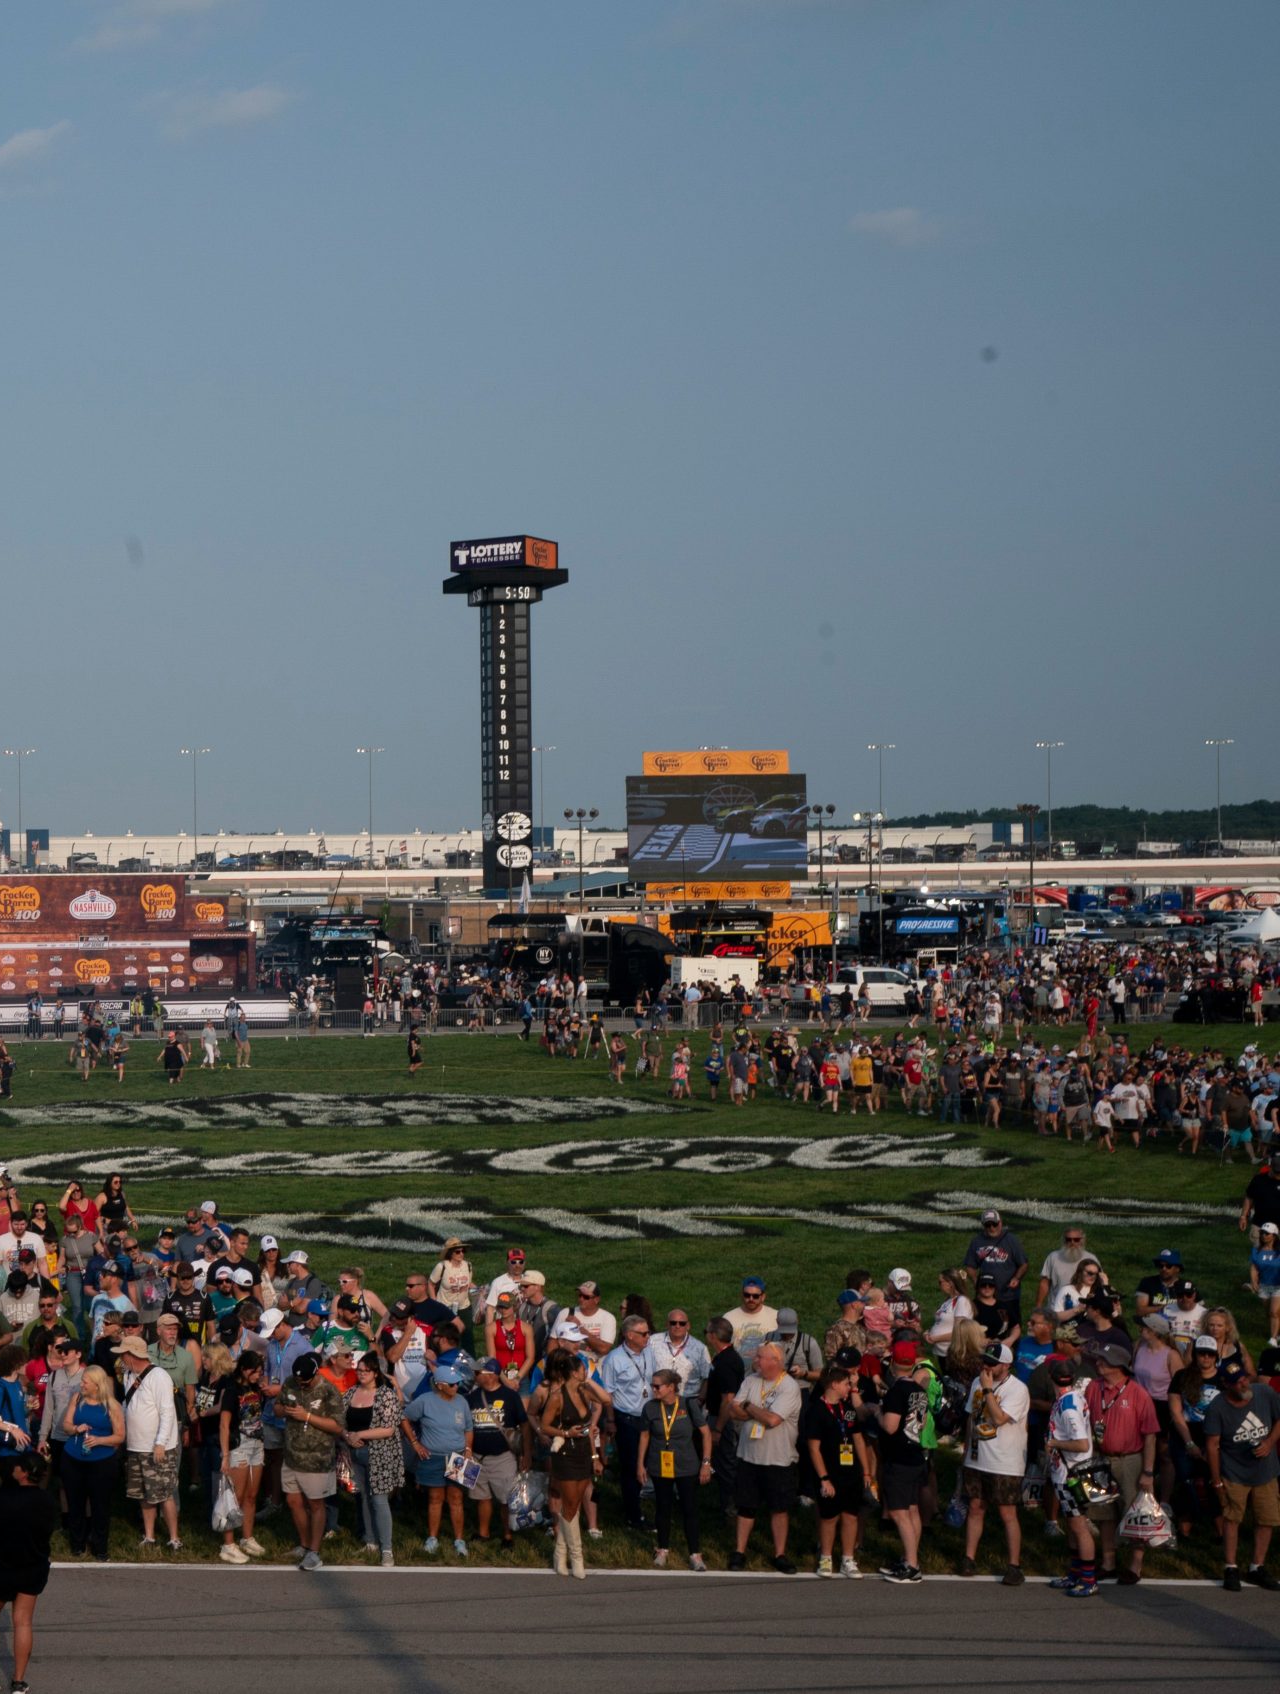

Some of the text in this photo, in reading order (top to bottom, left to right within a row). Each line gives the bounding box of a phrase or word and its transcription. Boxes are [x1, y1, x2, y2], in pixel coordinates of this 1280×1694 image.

[470, 542, 522, 558] LOTTERY
[472, 554, 520, 564] TENNESSEE
[505, 586, 530, 599] 5:50
[500, 605, 505, 614] 1
[500, 619, 506, 629] 2
[500, 634, 506, 644] 3
[500, 649, 506, 659] 4
[500, 664, 506, 674] 5
[500, 680, 506, 690] 6
[500, 695, 506, 705] 7
[501, 709, 506, 720] 8
[501, 725, 506, 735] 9
[499, 740, 509, 750] 10
[499, 755, 509, 765] 11
[499, 770, 510, 780] 12
[632, 824, 684, 860] TEXAS
[144, 888, 172, 905] Cracker
[4, 899, 35, 914] Barrel
[74, 902, 112, 912] NASHVILLE
[148, 898, 172, 914] Barrel
[14, 910, 40, 920] 400
[156, 909, 176, 918] 400
[899, 920, 954, 929] PROGRESSIVE
[1034, 927, 1047, 945] 11
[712, 943, 756, 956] Garner
[78, 961, 106, 974] Cracker
[83, 969, 106, 980] Barrel
[310, 1399, 322, 1409] 4
[474, 1412, 504, 1424] ELLITT
[1232, 1427, 1269, 1443] adidas
